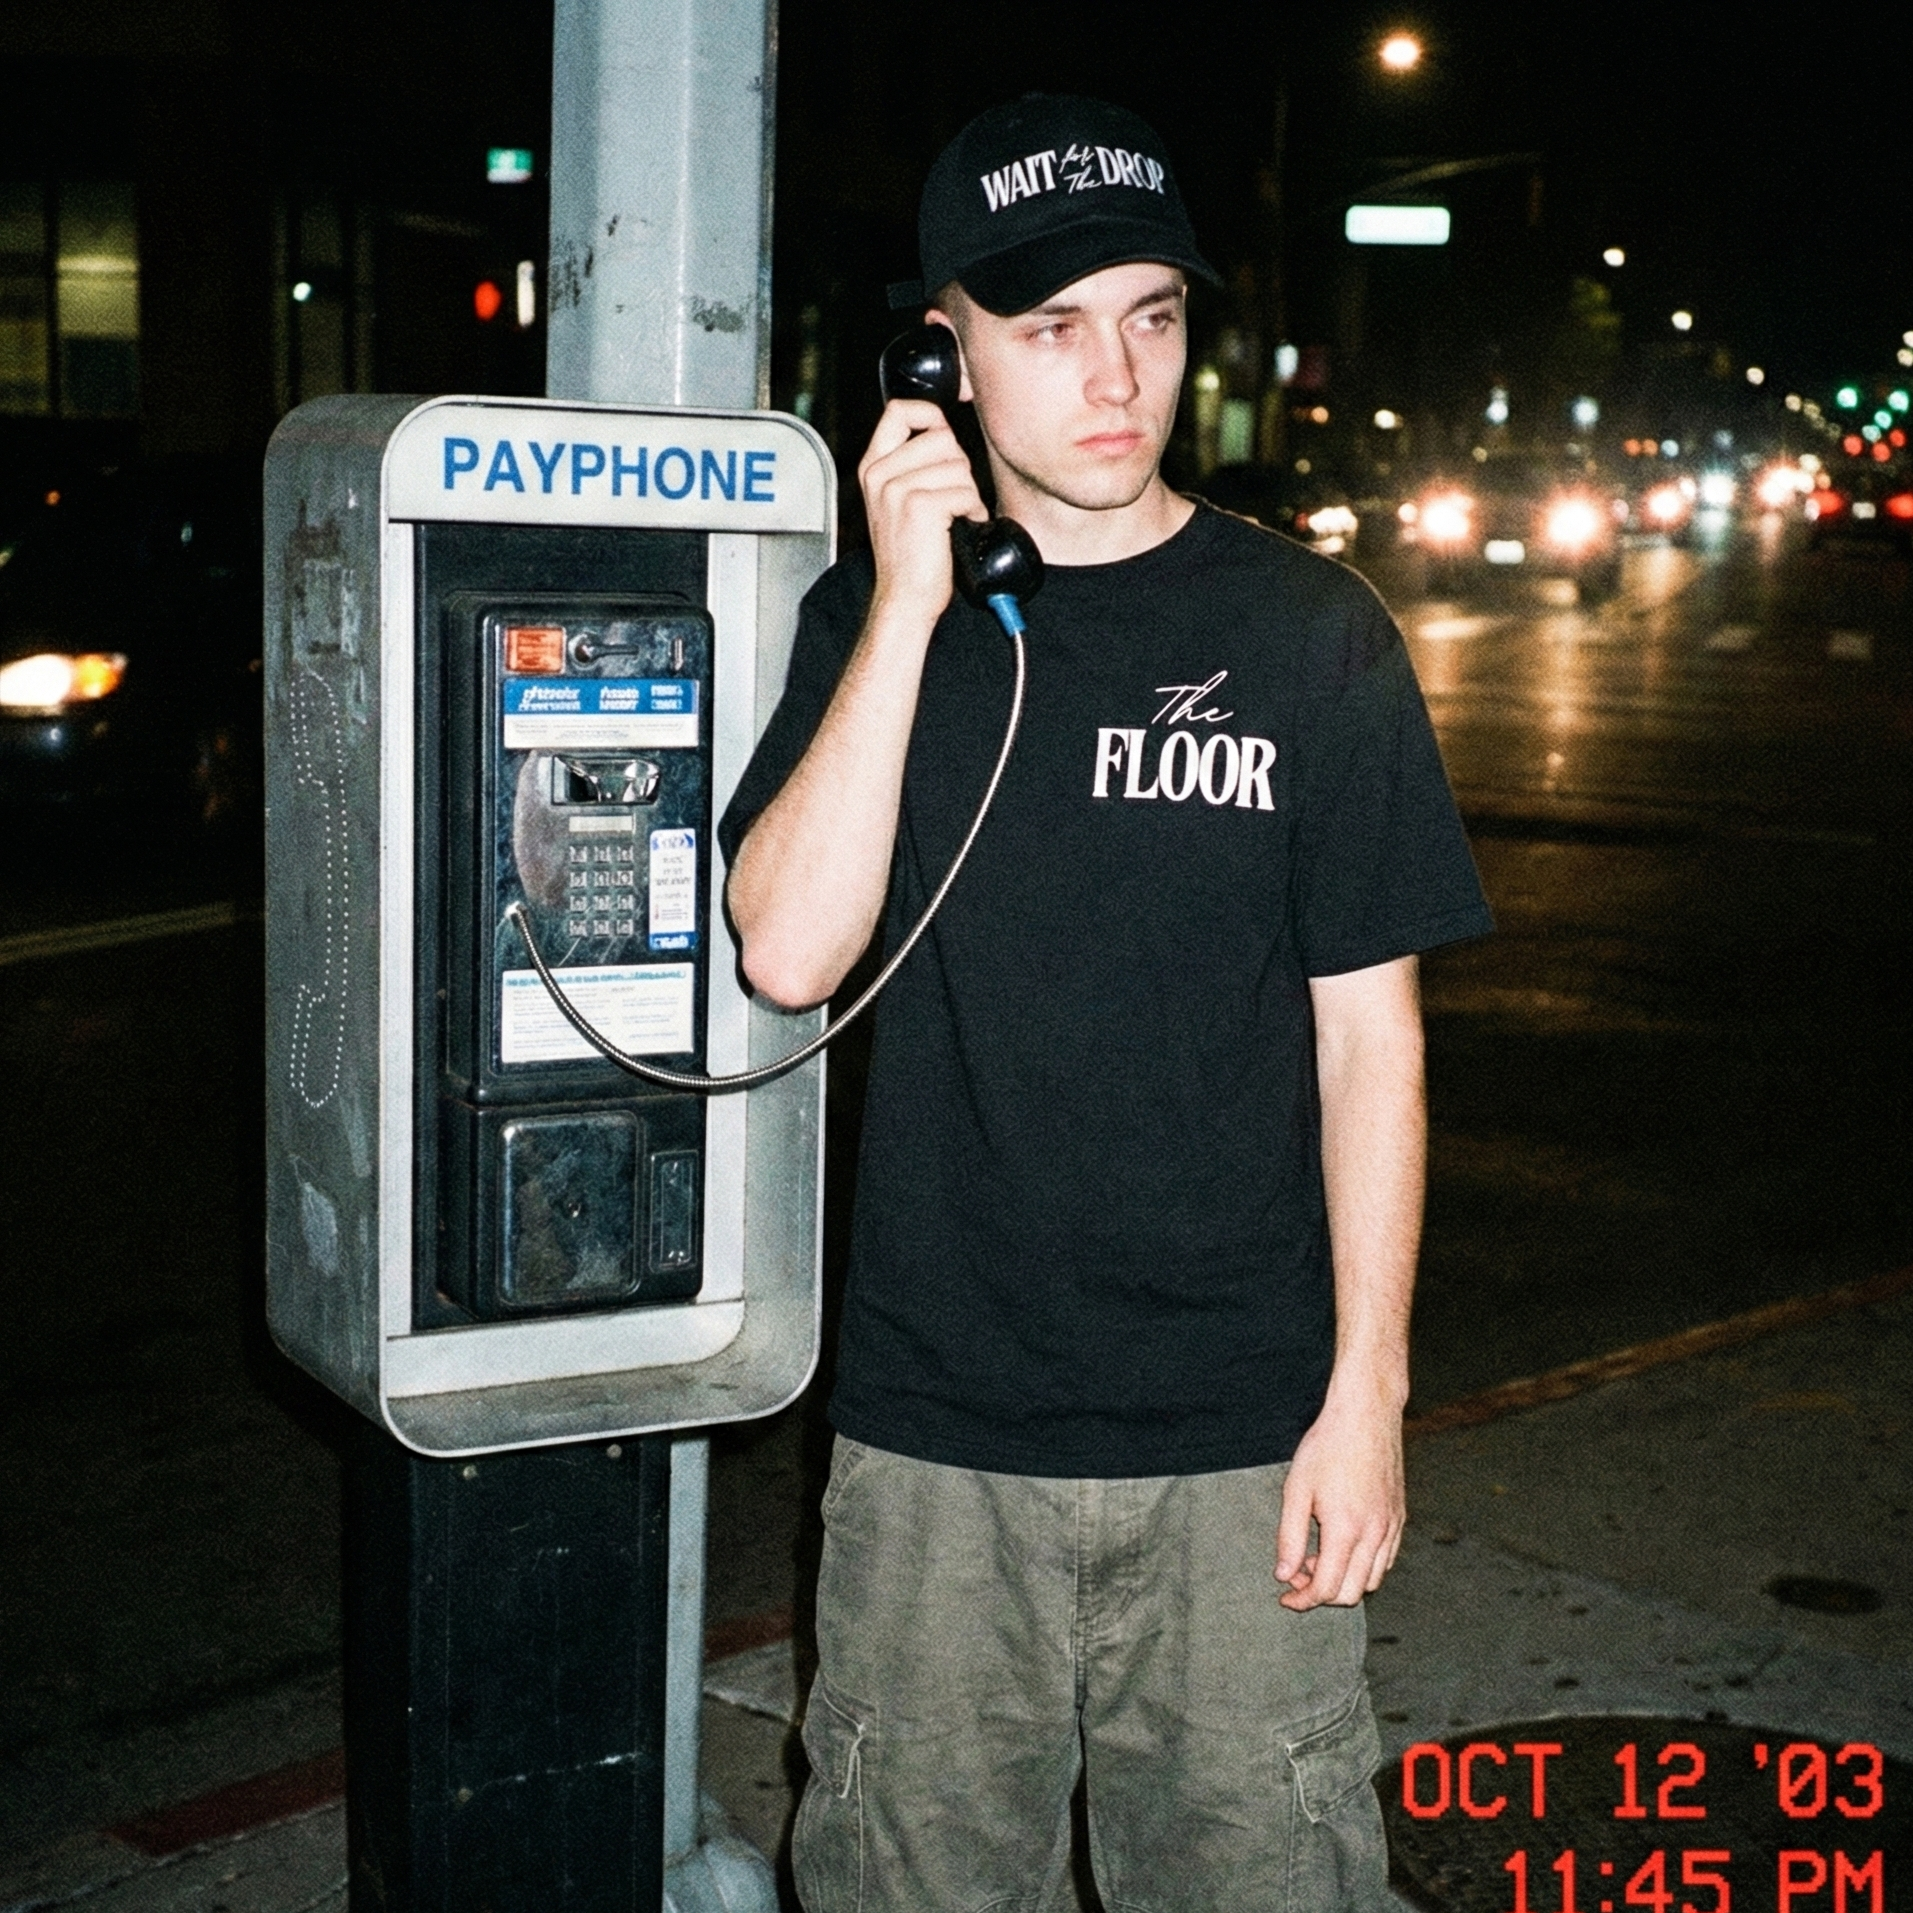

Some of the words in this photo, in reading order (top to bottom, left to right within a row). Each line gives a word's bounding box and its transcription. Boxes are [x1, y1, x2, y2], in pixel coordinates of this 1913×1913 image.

[980, 149, 1058, 213] WAIT
[1063, 164, 1103, 194] The
[1094, 146, 1165, 195] DROP
[443, 436, 776, 503] PAYPHONE
[1151, 669, 1234, 726] The
[1092, 727, 1277, 811] FLOOR
